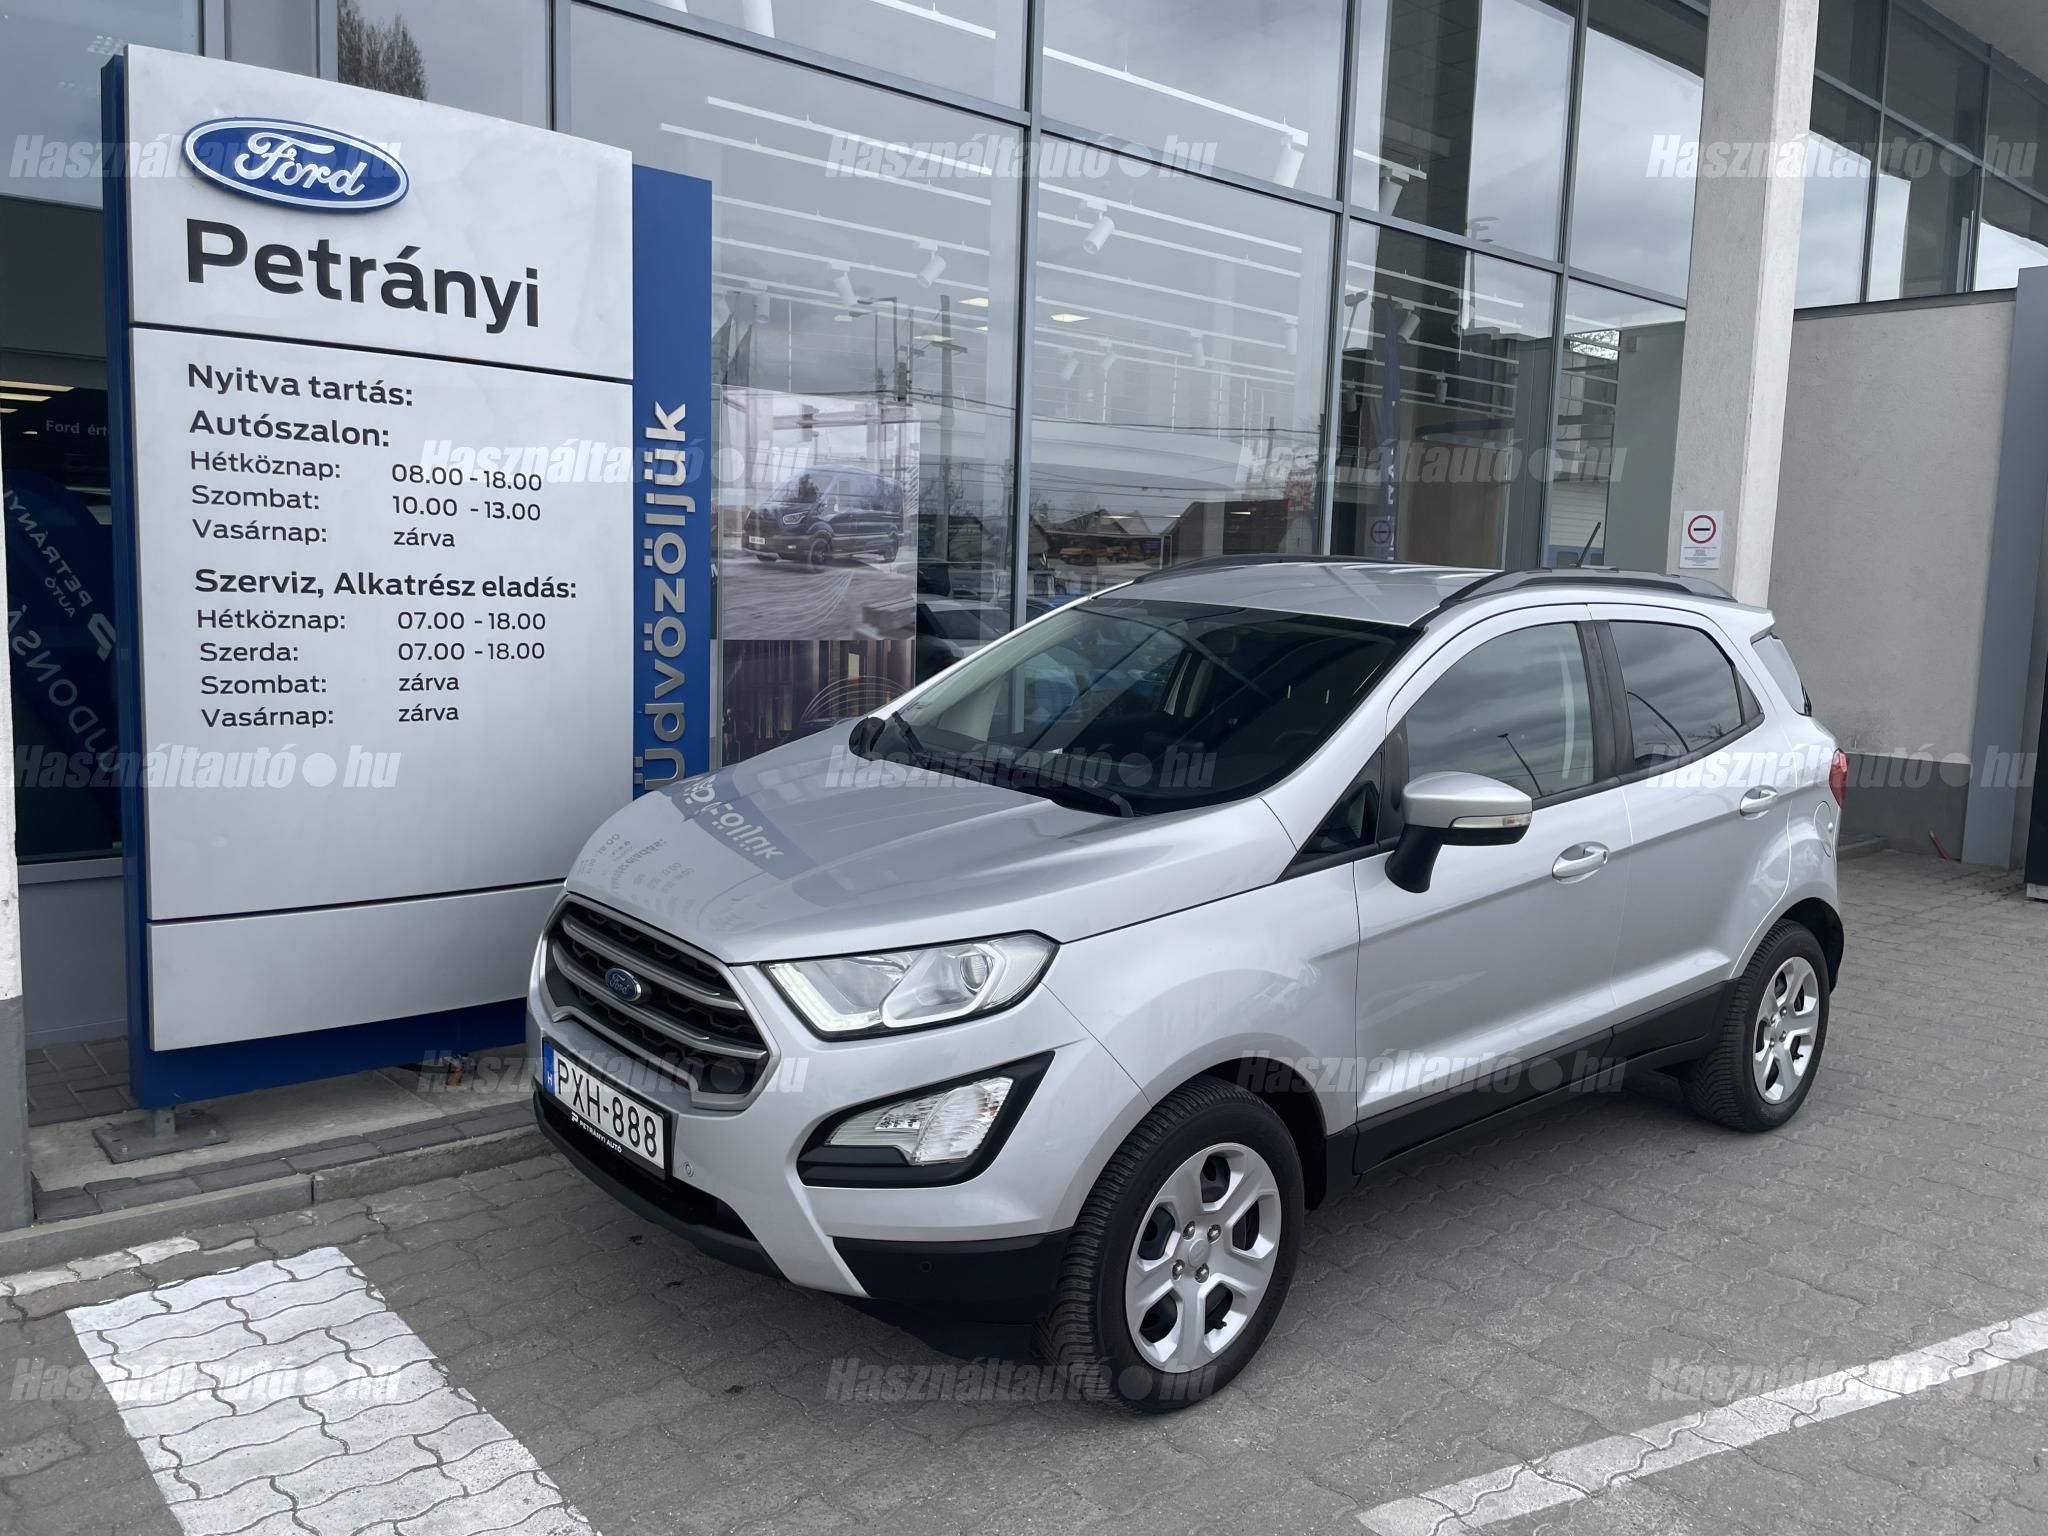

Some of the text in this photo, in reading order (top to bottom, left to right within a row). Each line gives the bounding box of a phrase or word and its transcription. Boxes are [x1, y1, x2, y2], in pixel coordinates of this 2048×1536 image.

[234, 131, 366, 197] Ford
[185, 218, 540, 336] Petrányi
[187, 363, 414, 407] Nyitva tartás:
[45, 419, 81, 434] Ford
[189, 409, 390, 447] Autószalon:
[190, 450, 342, 480] Hétköznap:
[391, 463, 463, 486] 08.00
[191, 485, 320, 510] Szombat:
[392, 495, 458, 517] 10.00
[191, 518, 456, 548] Vasárnap: zárva
[194, 568, 577, 599] Szerviz, Alkatrész eladás:
[633, 400, 696, 791] Üdvözöljük
[197, 608, 346, 633] Hétköznap:
[397, 611, 465, 630] 07.00
[199, 641, 299, 662] Szerda:
[398, 642, 465, 661] 07.00
[200, 672, 460, 695] Szombat: zárva
[200, 703, 460, 729] Vasárnap: zárva
[557, 1057, 658, 1159] PXH-888
